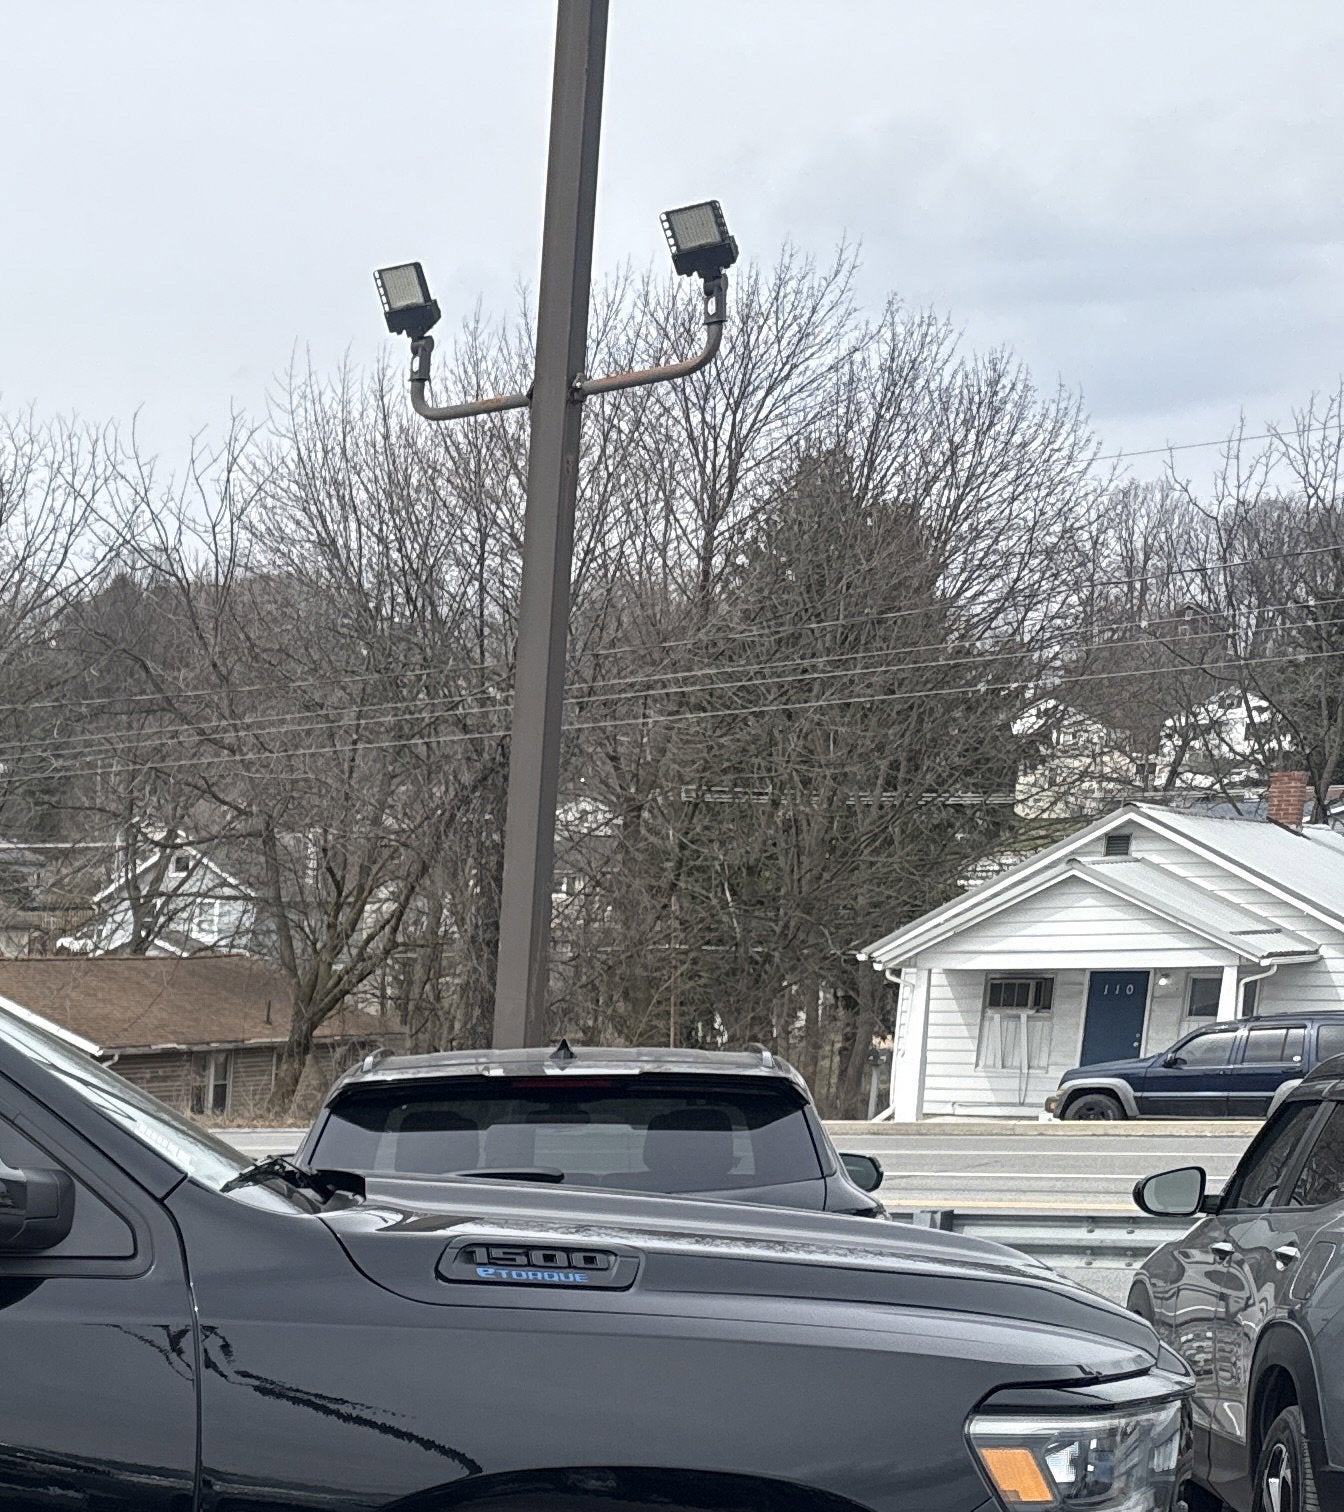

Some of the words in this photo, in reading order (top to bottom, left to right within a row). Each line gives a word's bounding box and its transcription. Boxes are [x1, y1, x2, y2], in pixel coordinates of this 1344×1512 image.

[1103, 984, 1134, 995] 110
[465, 1246, 611, 1271] 1500
[476, 1267, 589, 1283] eTORQUE
